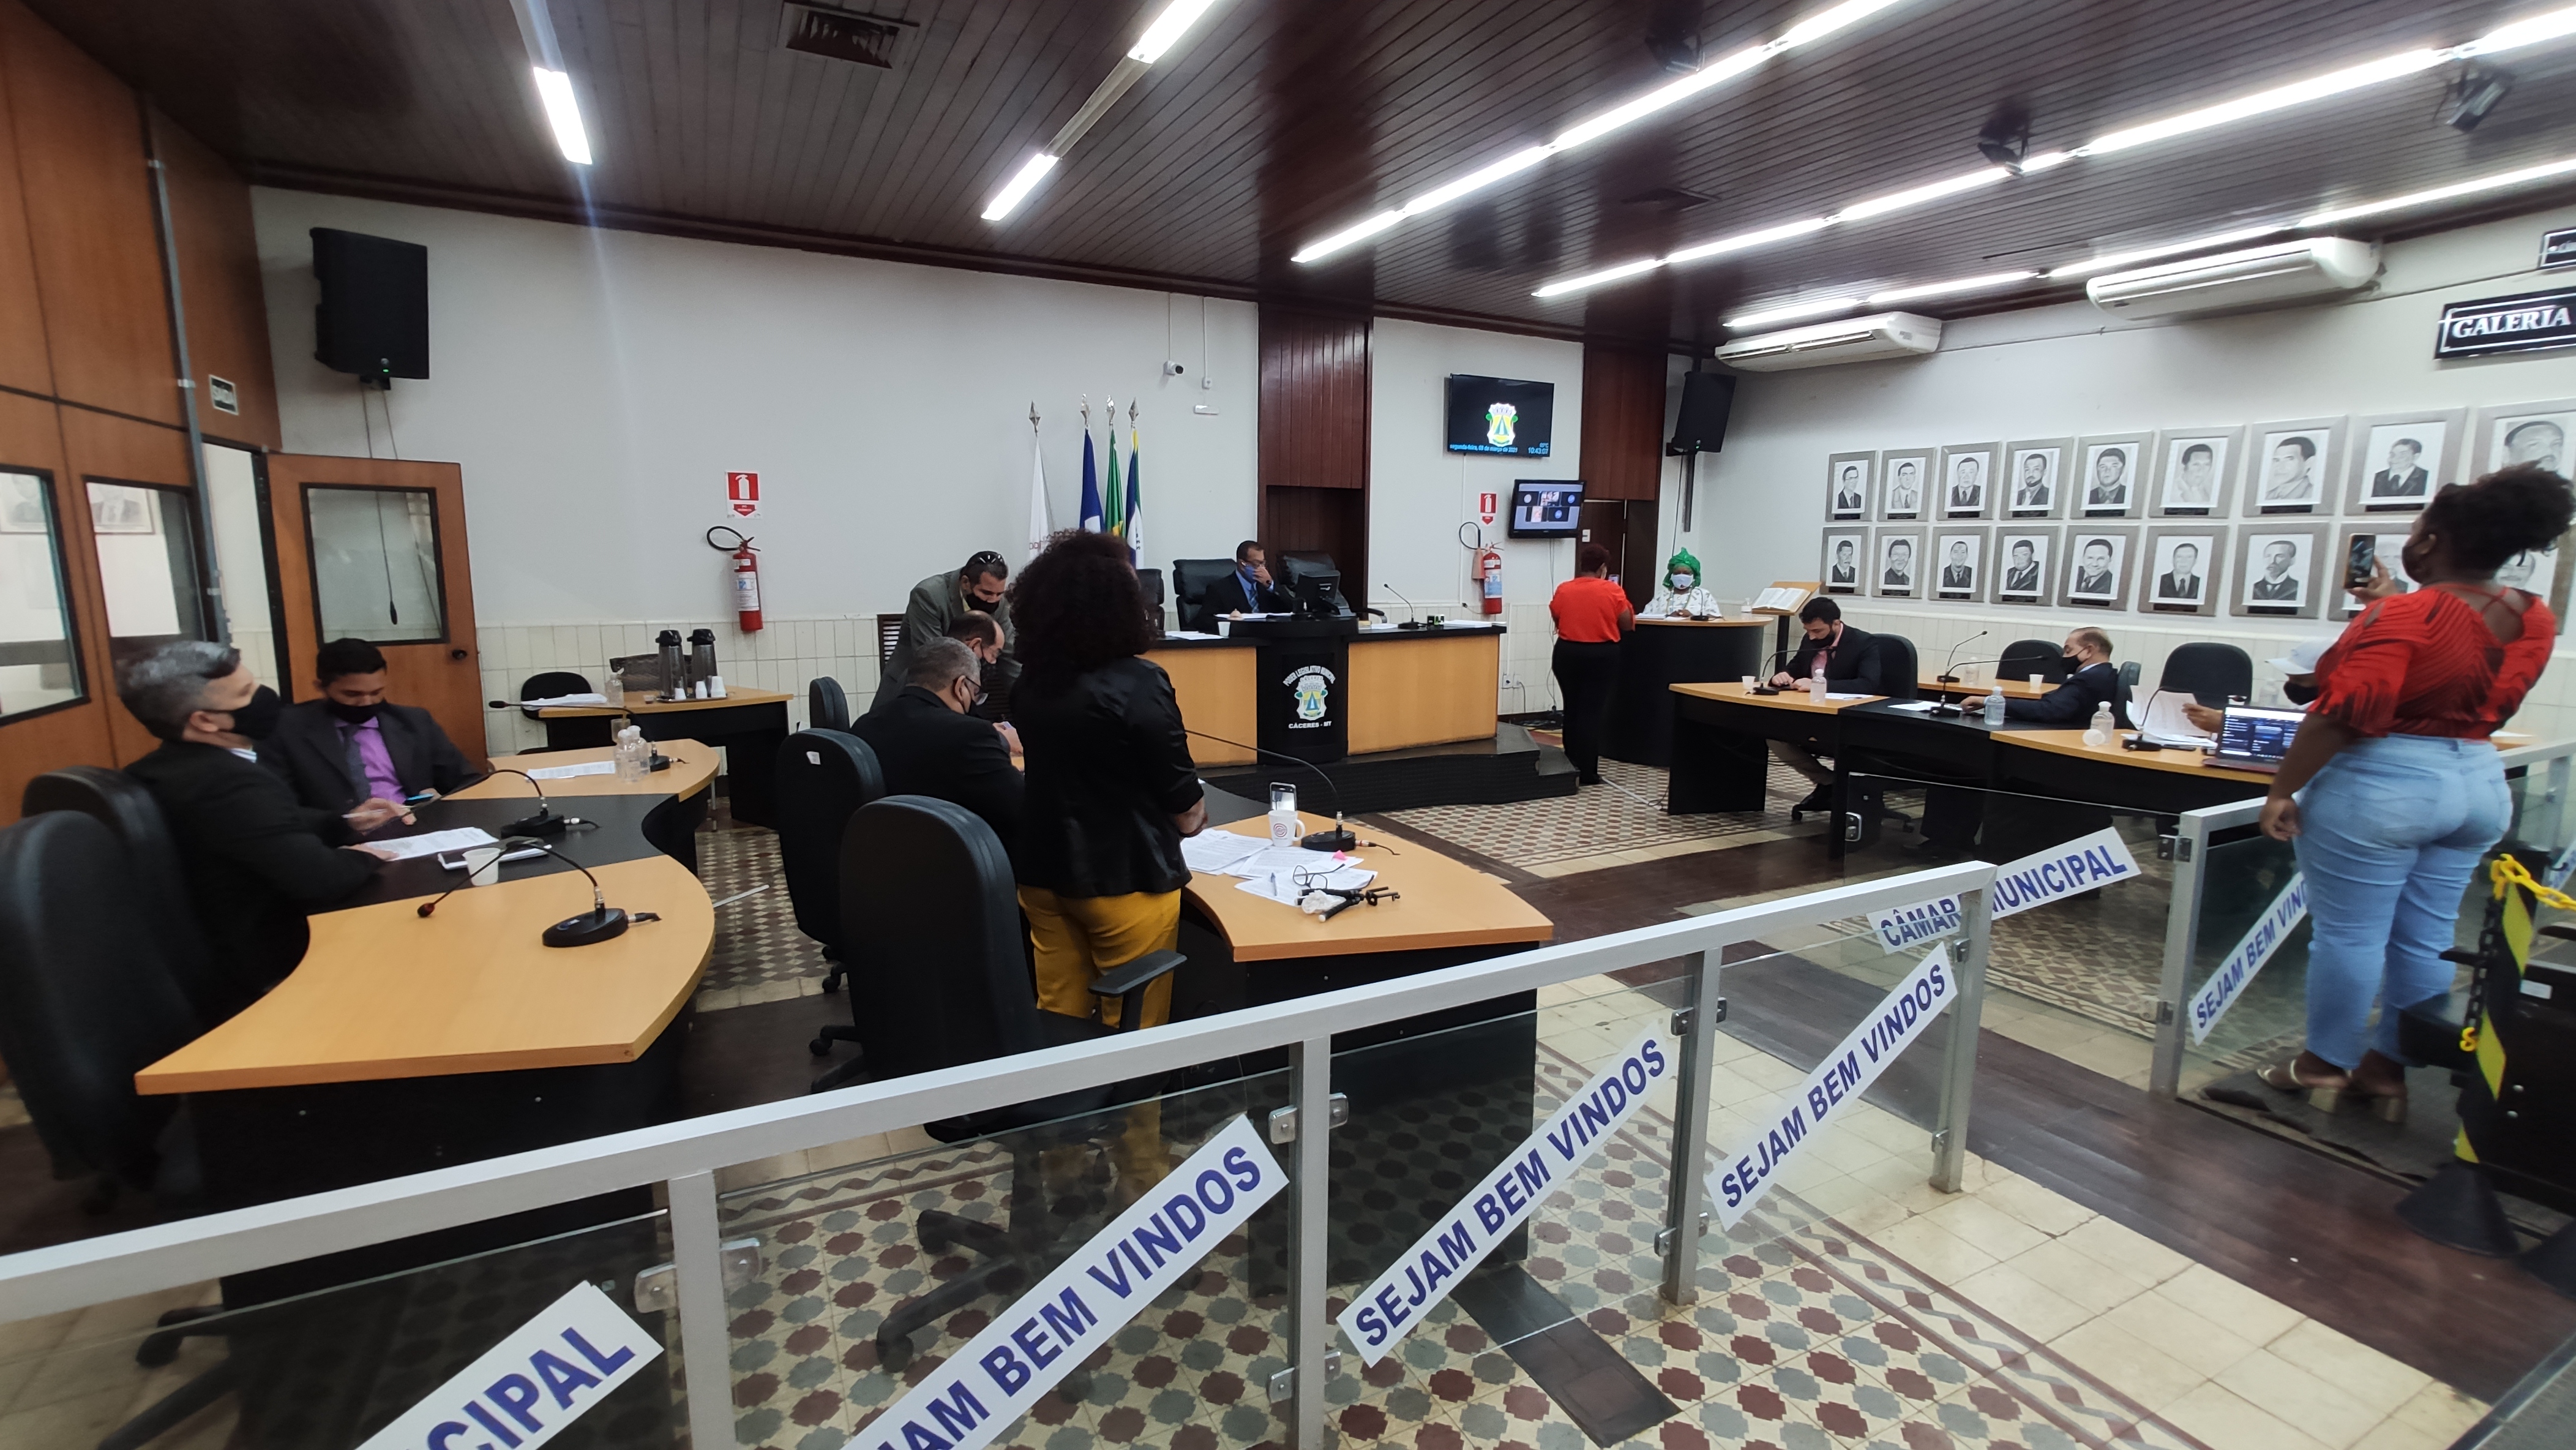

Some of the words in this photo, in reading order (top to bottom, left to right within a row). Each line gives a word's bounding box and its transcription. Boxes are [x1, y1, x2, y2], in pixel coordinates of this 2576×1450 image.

[2452, 307, 2571, 338] GALERIA
[1880, 893, 1962, 947] CÂMAR
[2196, 956, 2245, 1029] SEJAM
[2245, 917, 2276, 969] BEM
[1721, 1106, 1807, 1208] SEJAM
[1807, 1050, 1862, 1122] BEM
[1860, 964, 1945, 1064] VINDOS
[1356, 1220, 1477, 1346] SEJAM
[1473, 1149, 1552, 1236] BEM
[1546, 1039, 1665, 1162] VINDOS
[877, 1380, 990, 1450] AM
[979, 1286, 1099, 1397] BEM
[1085, 1147, 1262, 1299] VINDOS
[426, 1326, 637, 1450] CIPAL
